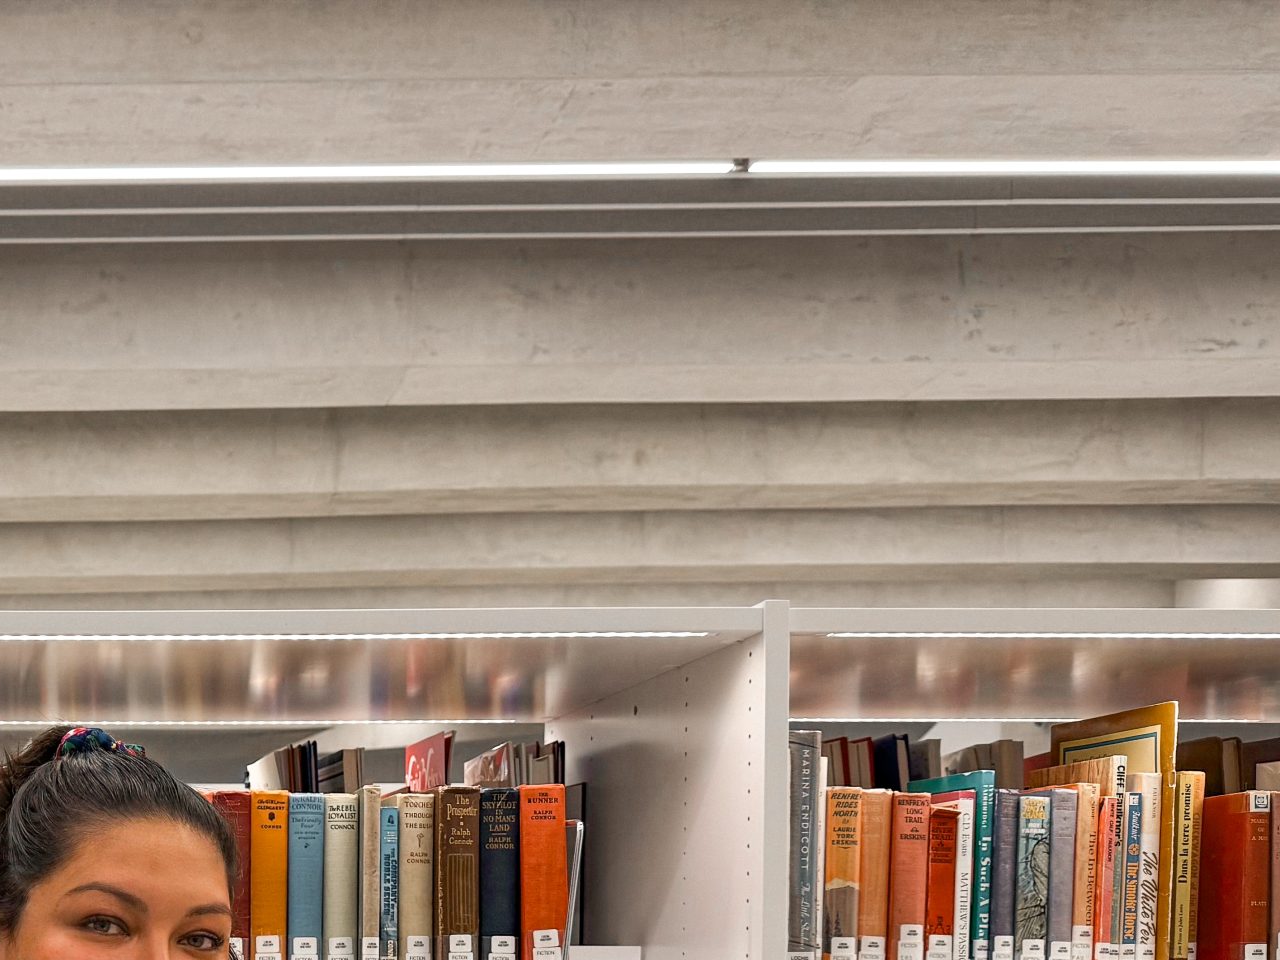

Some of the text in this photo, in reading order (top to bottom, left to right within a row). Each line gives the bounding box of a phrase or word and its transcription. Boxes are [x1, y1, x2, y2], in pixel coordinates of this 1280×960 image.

[447, 804, 478, 820] Prospector
[800, 749, 810, 870] MARINA ENDICOTT
